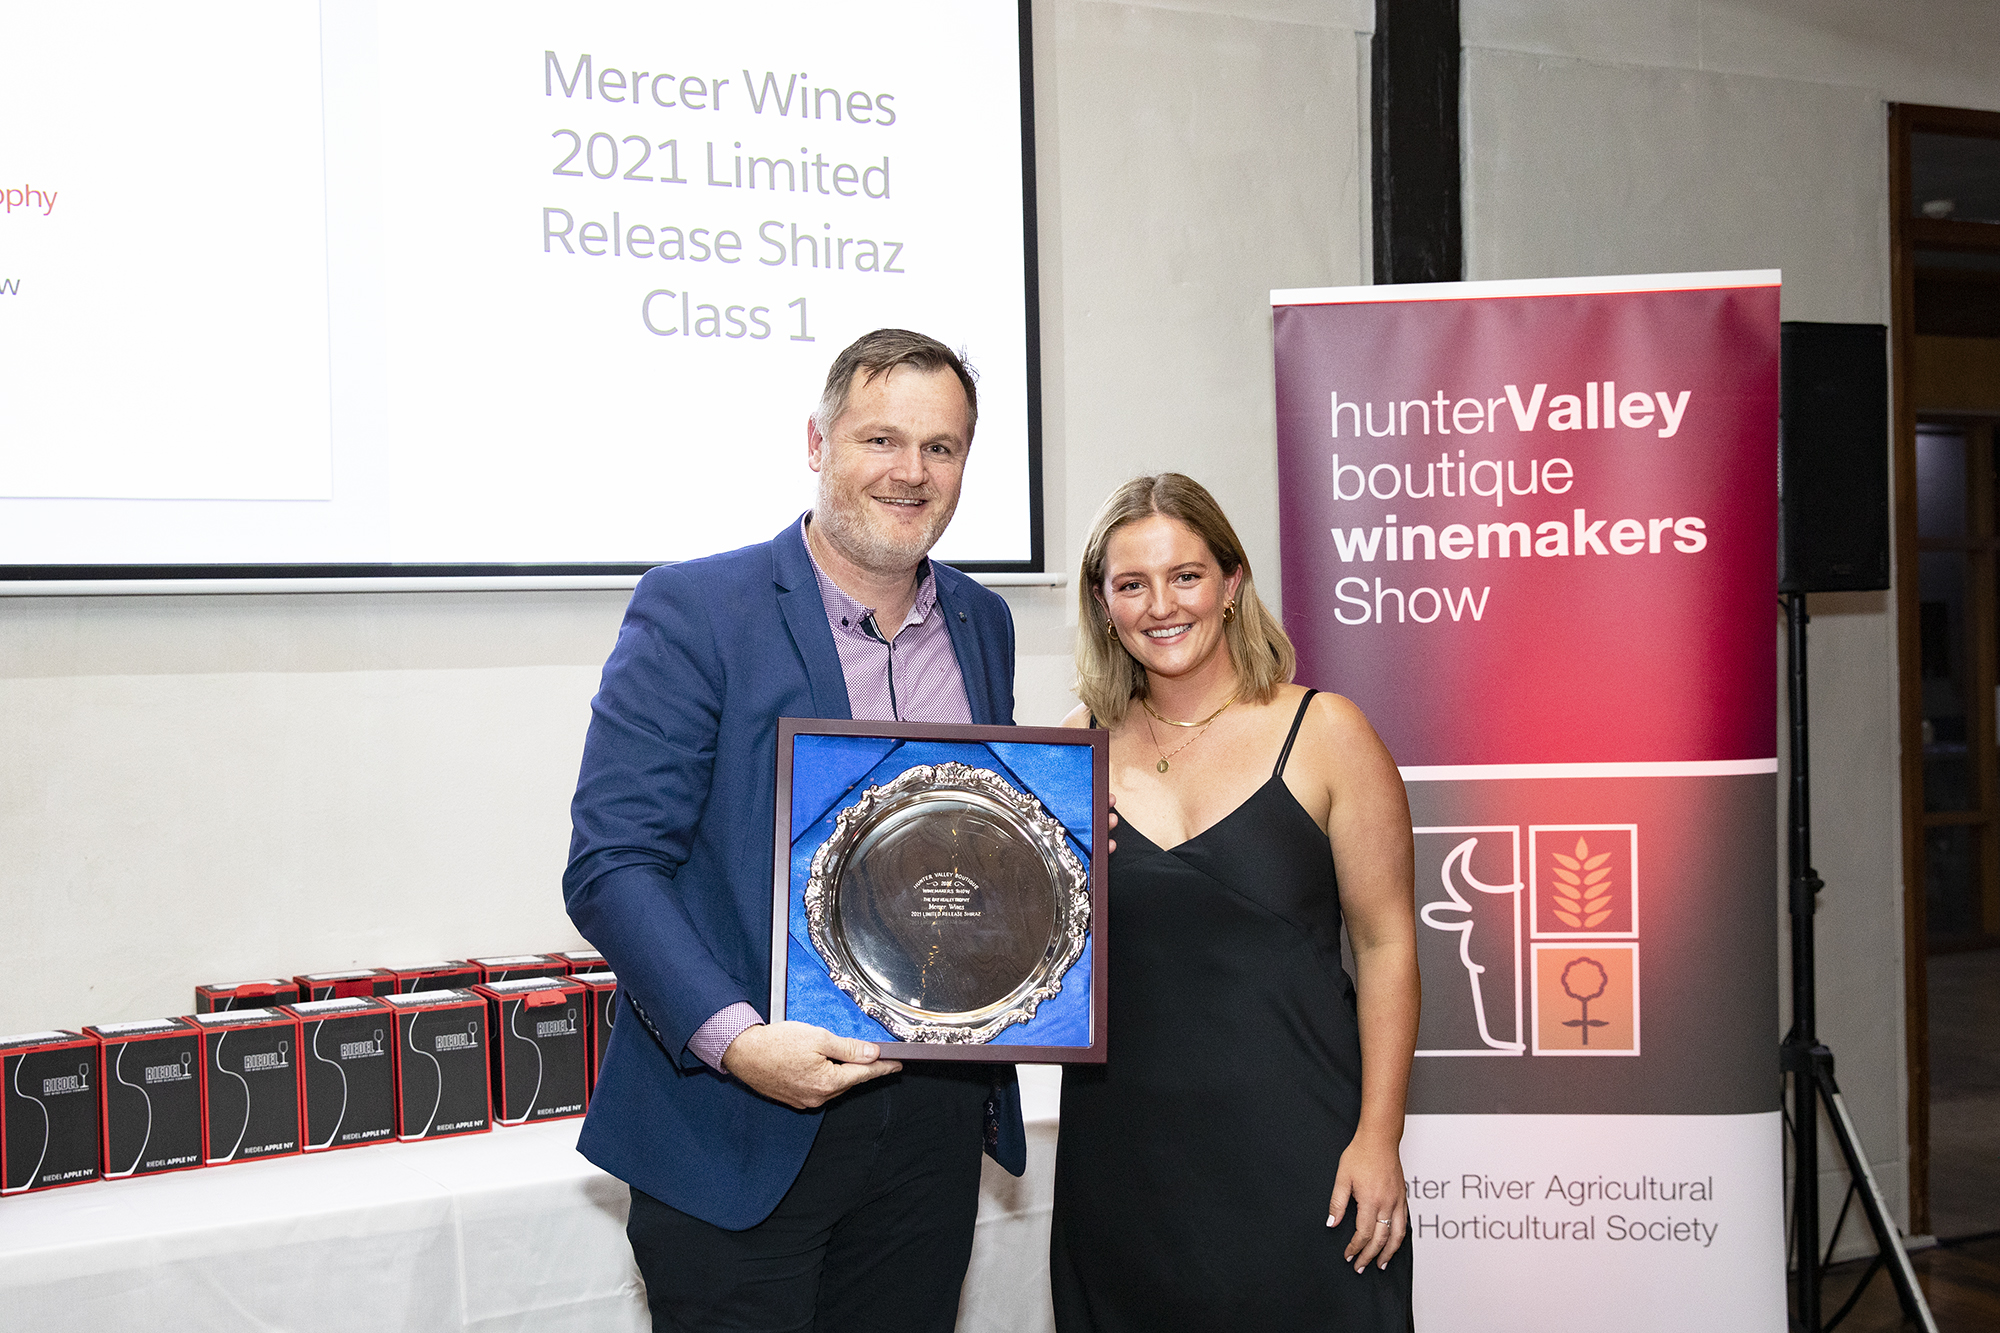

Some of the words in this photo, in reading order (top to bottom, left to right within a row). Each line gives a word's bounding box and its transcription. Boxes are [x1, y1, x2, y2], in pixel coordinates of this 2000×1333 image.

[544, 50, 729, 111] Mercer
[742, 69, 897, 126] Wines
[552, 128, 687, 184] 2021
[706, 141, 891, 199] Limited
[0, 184, 58, 216] phy
[543, 206, 742, 264] Release
[758, 220, 905, 273] Shiraz
[641, 288, 772, 340] Class
[787, 297, 816, 342] 1
[1330, 381, 1692, 438] hunterValley
[1331, 449, 1574, 508] boutique
[1330, 508, 1708, 563] winemakers
[1333, 576, 1491, 625] Show
[913, 874, 933, 890] HUNTER
[954, 873, 979, 890] BOUTIQUE
[537, 1019, 569, 1035] RIEDEL
[341, 1040, 375, 1057] RIEDEL
[435, 1032, 469, 1049] RIEDEL
[244, 1052, 279, 1069] RIEDEL
[145, 1063, 181, 1081] RIEDEL
[43, 1075, 79, 1093] RIEDEL
[555, 1105, 571, 1113] APPLE
[455, 1121, 473, 1129] APPLE
[342, 1133, 361, 1141] RIEDEL
[362, 1130, 380, 1138] APPLE
[380, 1128, 390, 1136] NY
[264, 1143, 283, 1151] APPLE
[284, 1141, 294, 1149] NY
[146, 1160, 165, 1168] RIEDEL
[166, 1156, 186, 1165] APPLE
[42, 1174, 62, 1182] RIEDEL
[63, 1170, 82, 1179] APPLE
[83, 1168, 93, 1176] NY
[1461, 1174, 1535, 1200] River
[1544, 1174, 1713, 1207] Agricultural
[1418, 1213, 1595, 1241] Horticultural
[1606, 1214, 1719, 1248] Society
